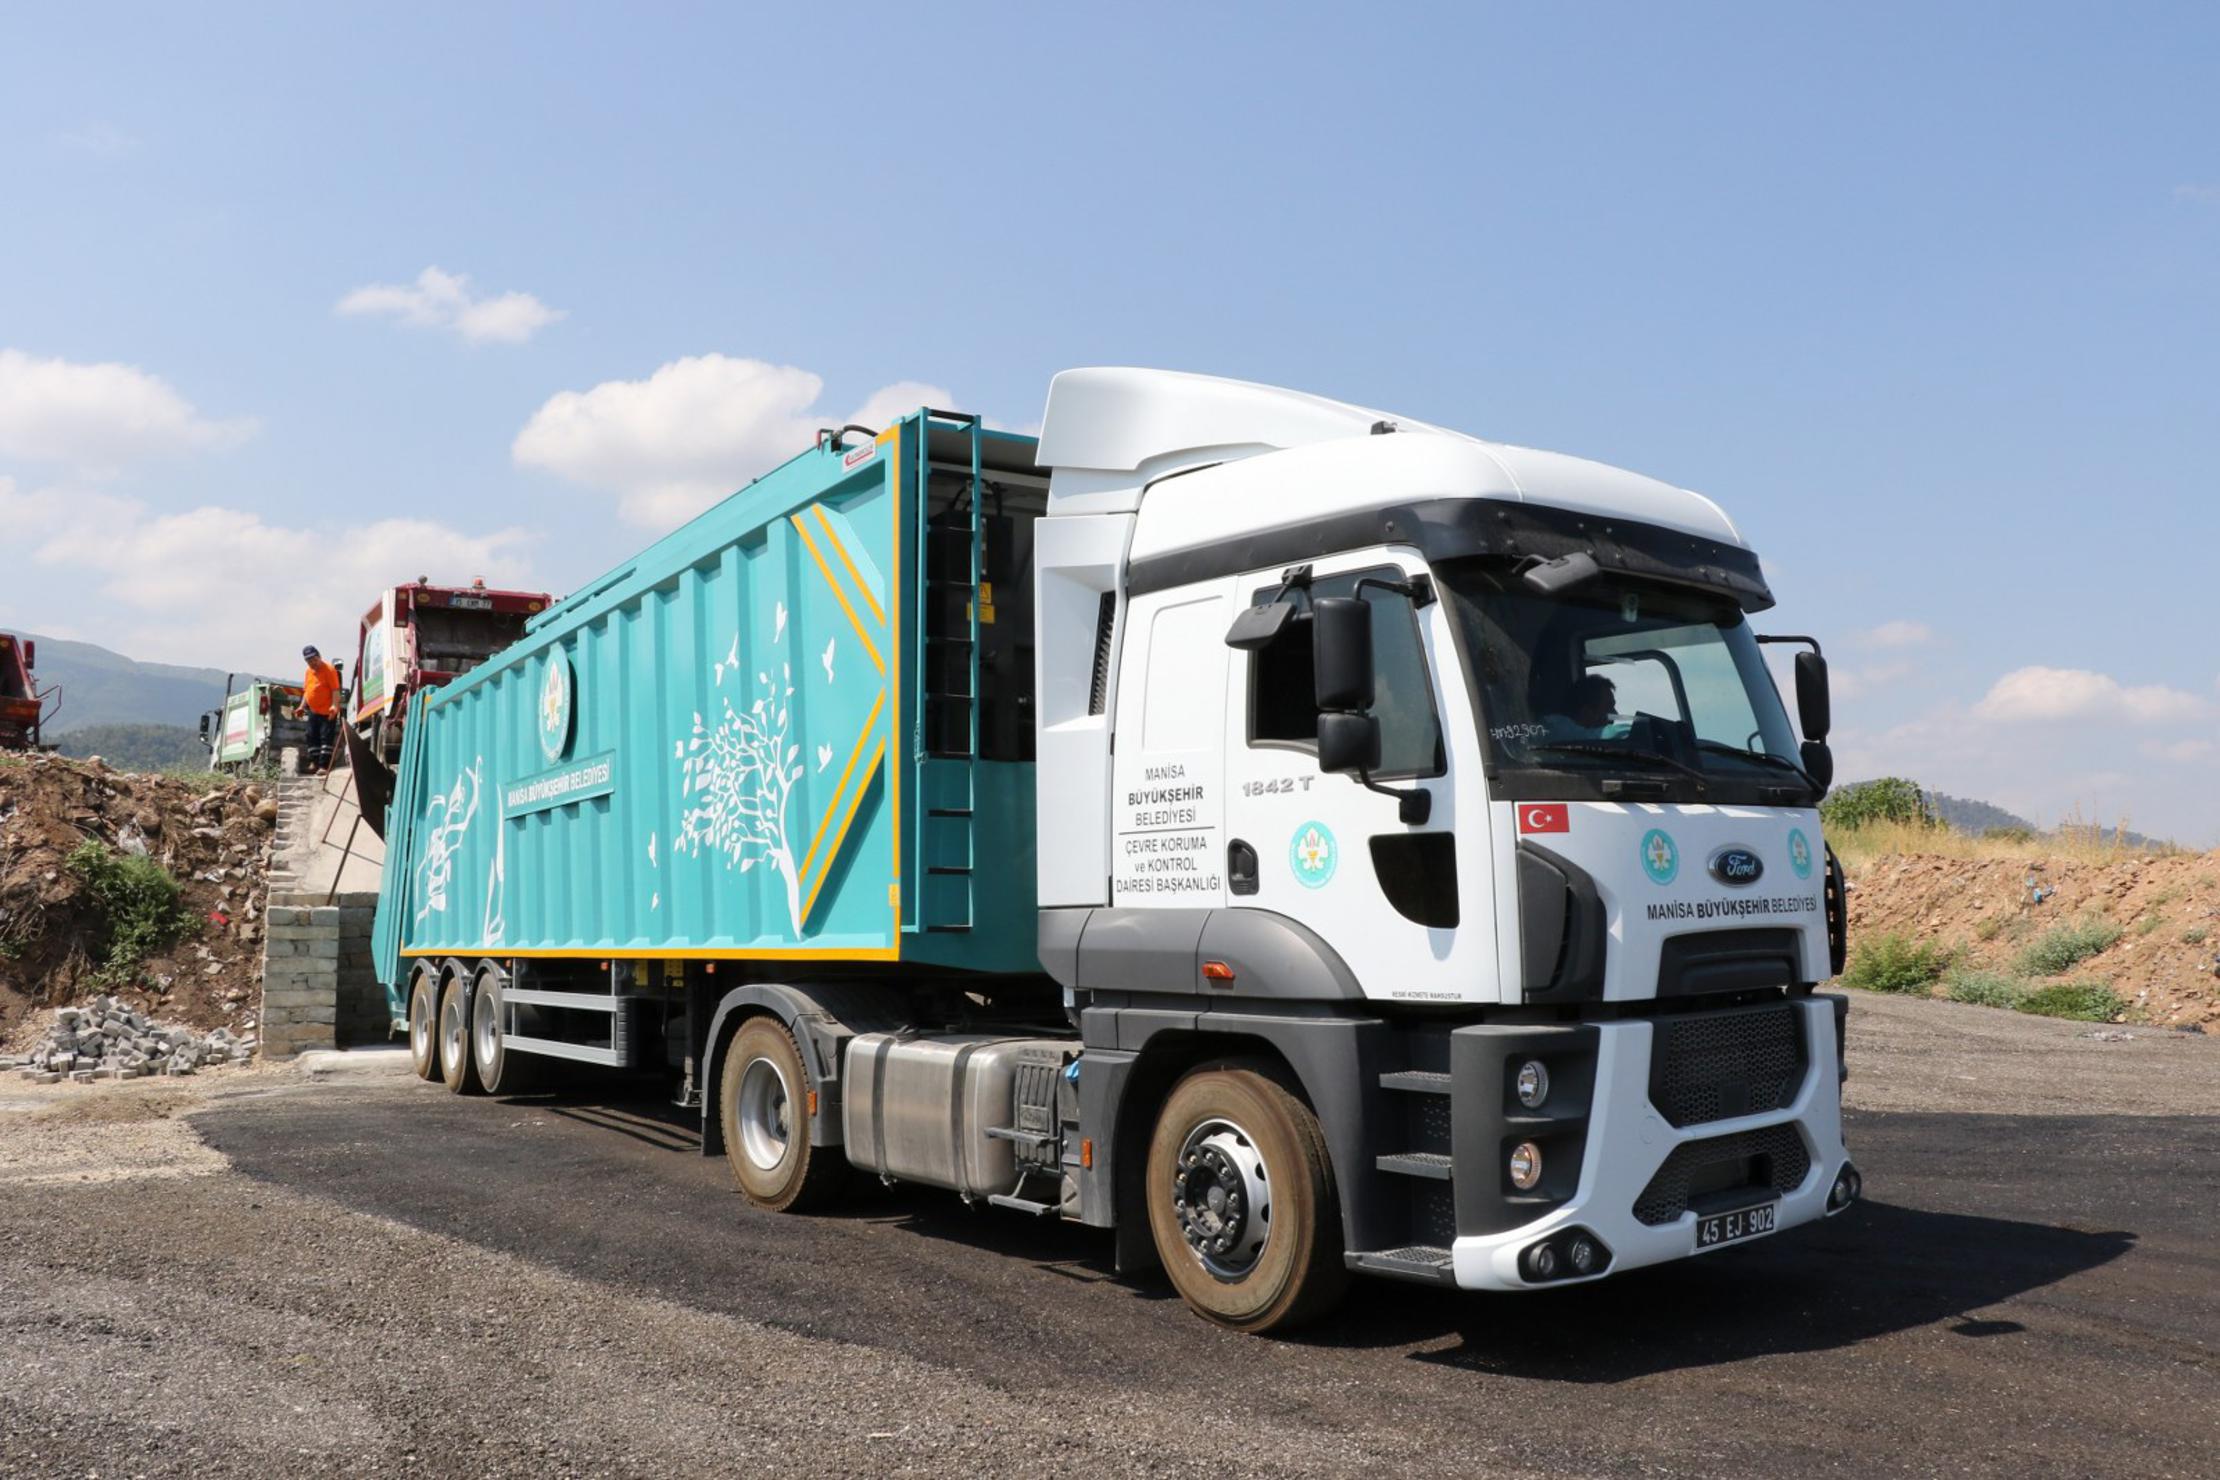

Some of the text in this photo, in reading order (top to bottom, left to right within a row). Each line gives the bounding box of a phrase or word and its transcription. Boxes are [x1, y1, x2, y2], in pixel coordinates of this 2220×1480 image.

[1145, 762, 1186, 781] MANİSA
[1128, 783, 1204, 806] BÜYÜKŞEHİR
[1242, 774, 1315, 798] 1842 T
[1135, 805, 1197, 826] BELEDİYESİ
[1125, 836, 1207, 857] ÇEVRE KORUMA
[1134, 857, 1198, 873] ve KONTROL
[1725, 854, 1756, 877] Ford
[1116, 873, 1221, 896] DAİRESİ BAŞKANLIĞI
[1647, 894, 1817, 921] MANİSA BÜYÜKŞEHİR BELEDİYESİ
[1702, 1206, 1774, 1244] 45 EJ 902
